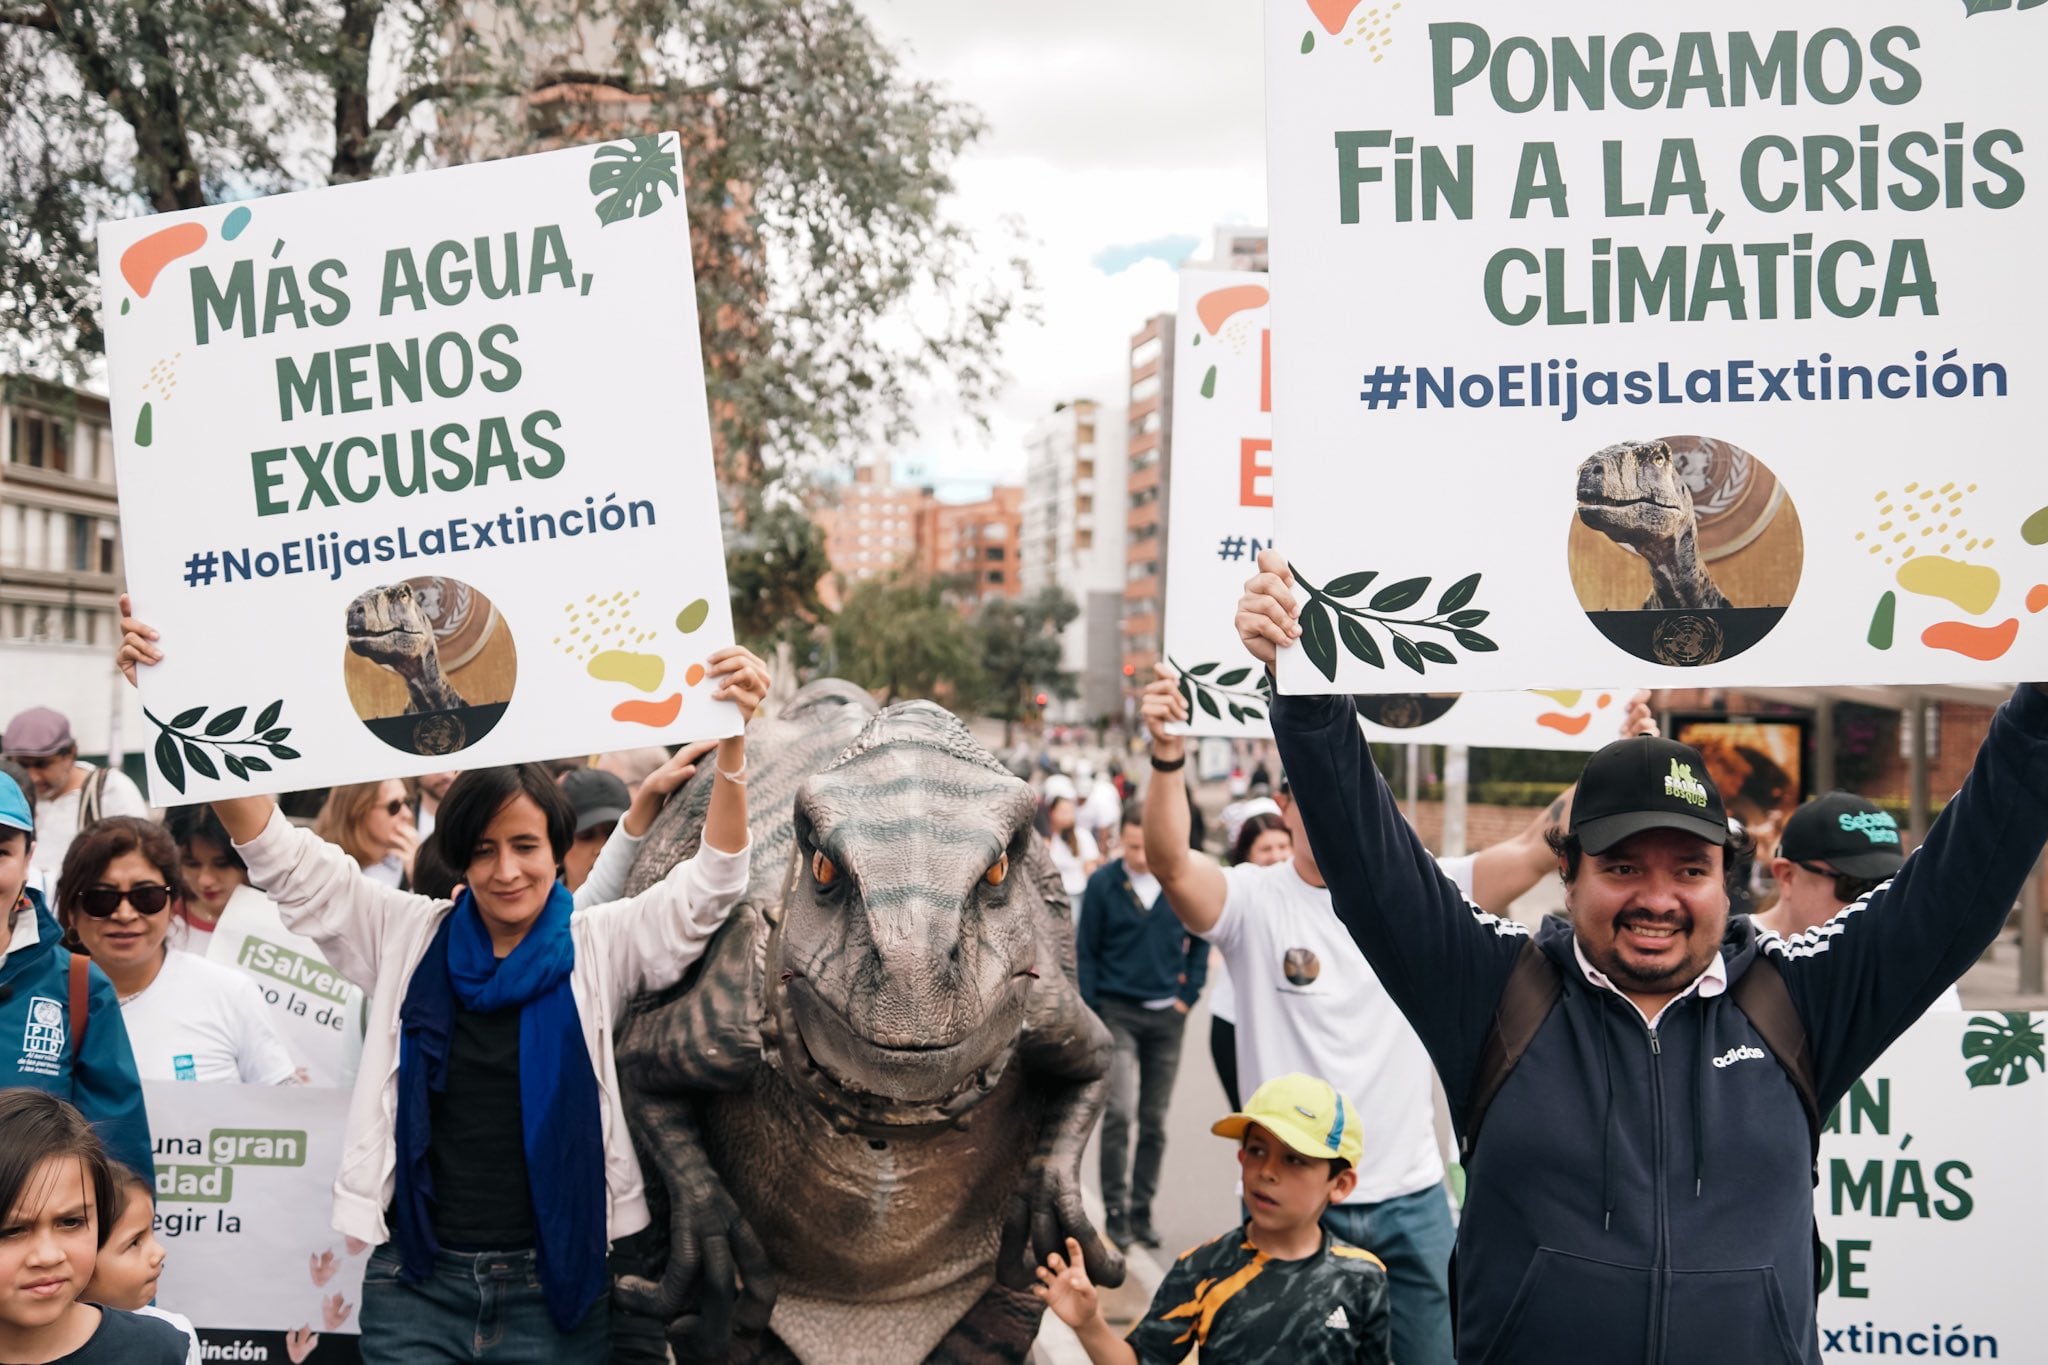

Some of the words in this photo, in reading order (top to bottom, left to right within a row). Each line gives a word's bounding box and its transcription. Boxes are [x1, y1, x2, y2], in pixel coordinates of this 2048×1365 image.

[1428, 21, 1922, 116] PONGAMOS
[1509, 141, 1570, 219] A
[1602, 137, 1709, 218] LA
[189, 238, 352, 346] MÁS
[379, 224, 594, 318] AGUA,
[275, 323, 522, 423] MENOS
[1360, 347, 2008, 422] #NoElijasLaExtinción
[250, 409, 566, 517] EXCUSAS
[183, 491, 656, 588] #NoElijasLaExtinción
[286, 992, 308, 1017] la
[1712, 1044, 1765, 1068] adidas
[213, 1136, 298, 1165] gran
[1829, 1133, 1975, 1222] MÁS
[217, 1209, 242, 1233] la
